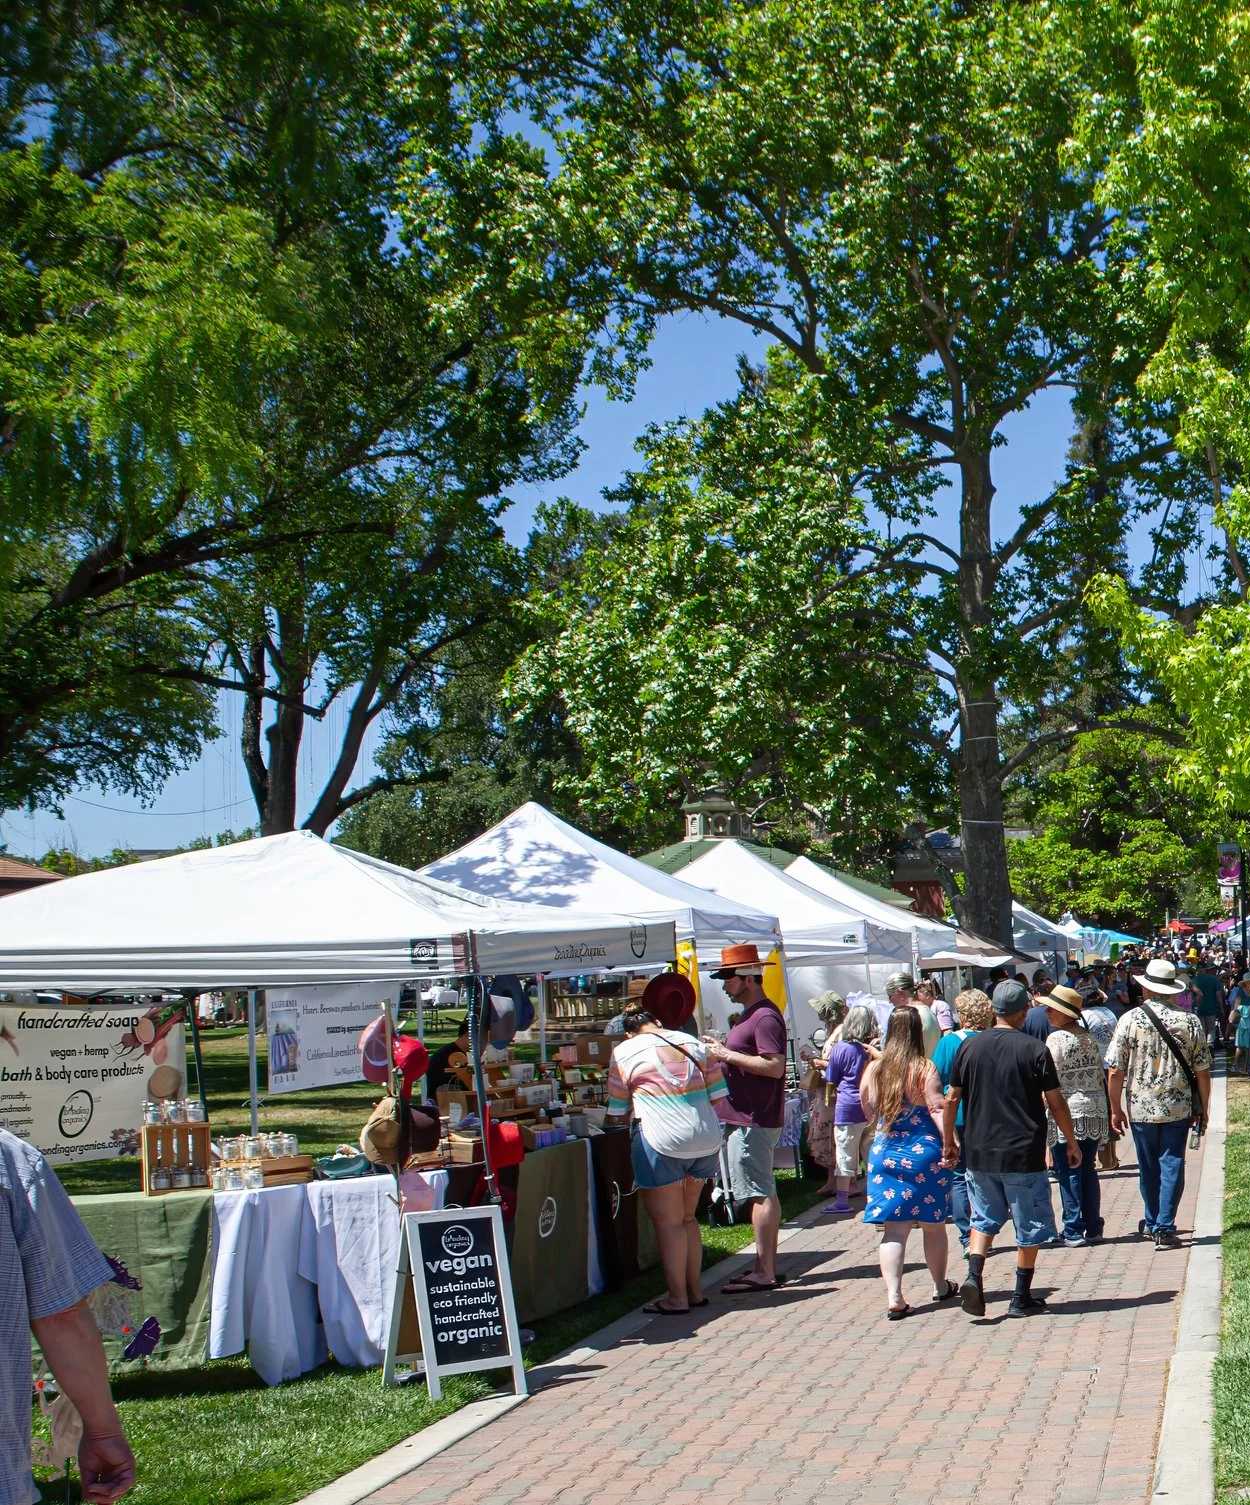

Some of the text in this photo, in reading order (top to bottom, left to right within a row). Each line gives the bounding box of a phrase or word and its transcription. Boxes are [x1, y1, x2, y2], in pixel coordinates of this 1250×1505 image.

[18, 1011, 140, 1033] handcrafted soap
[50, 1047, 77, 1060] vegan
[84, 1044, 109, 1059] hemp
[1, 1062, 144, 1084] bath & body care products
[426, 1253, 493, 1275] vegan
[430, 1277, 496, 1294] sustainable
[433, 1292, 498, 1309] eco friendly
[434, 1307, 500, 1325] handcrafted
[437, 1321, 503, 1344] organic
